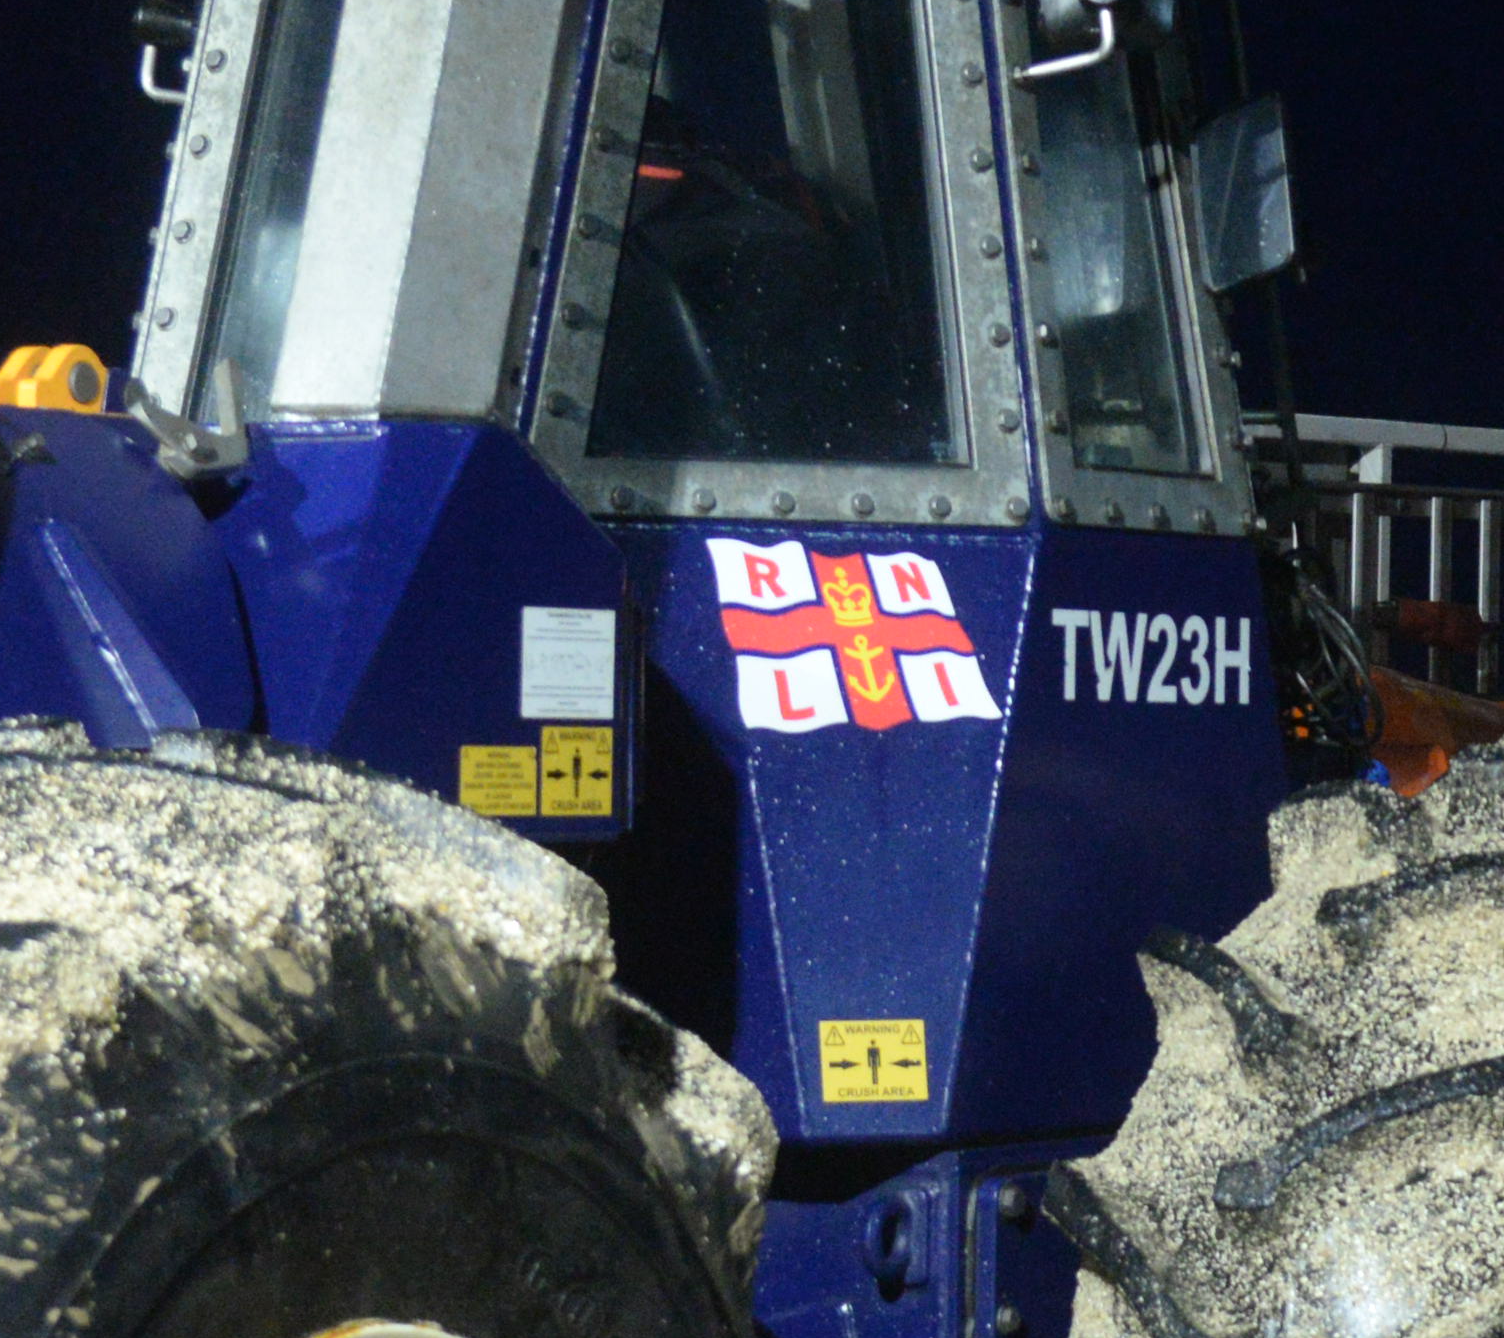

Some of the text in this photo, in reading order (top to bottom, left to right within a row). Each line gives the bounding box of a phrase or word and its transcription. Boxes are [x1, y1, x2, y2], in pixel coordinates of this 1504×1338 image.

[1052, 608, 1251, 705] TW23H
[844, 1024, 901, 1034] WARNING
[837, 1086, 915, 1097] CRUSH AREA
